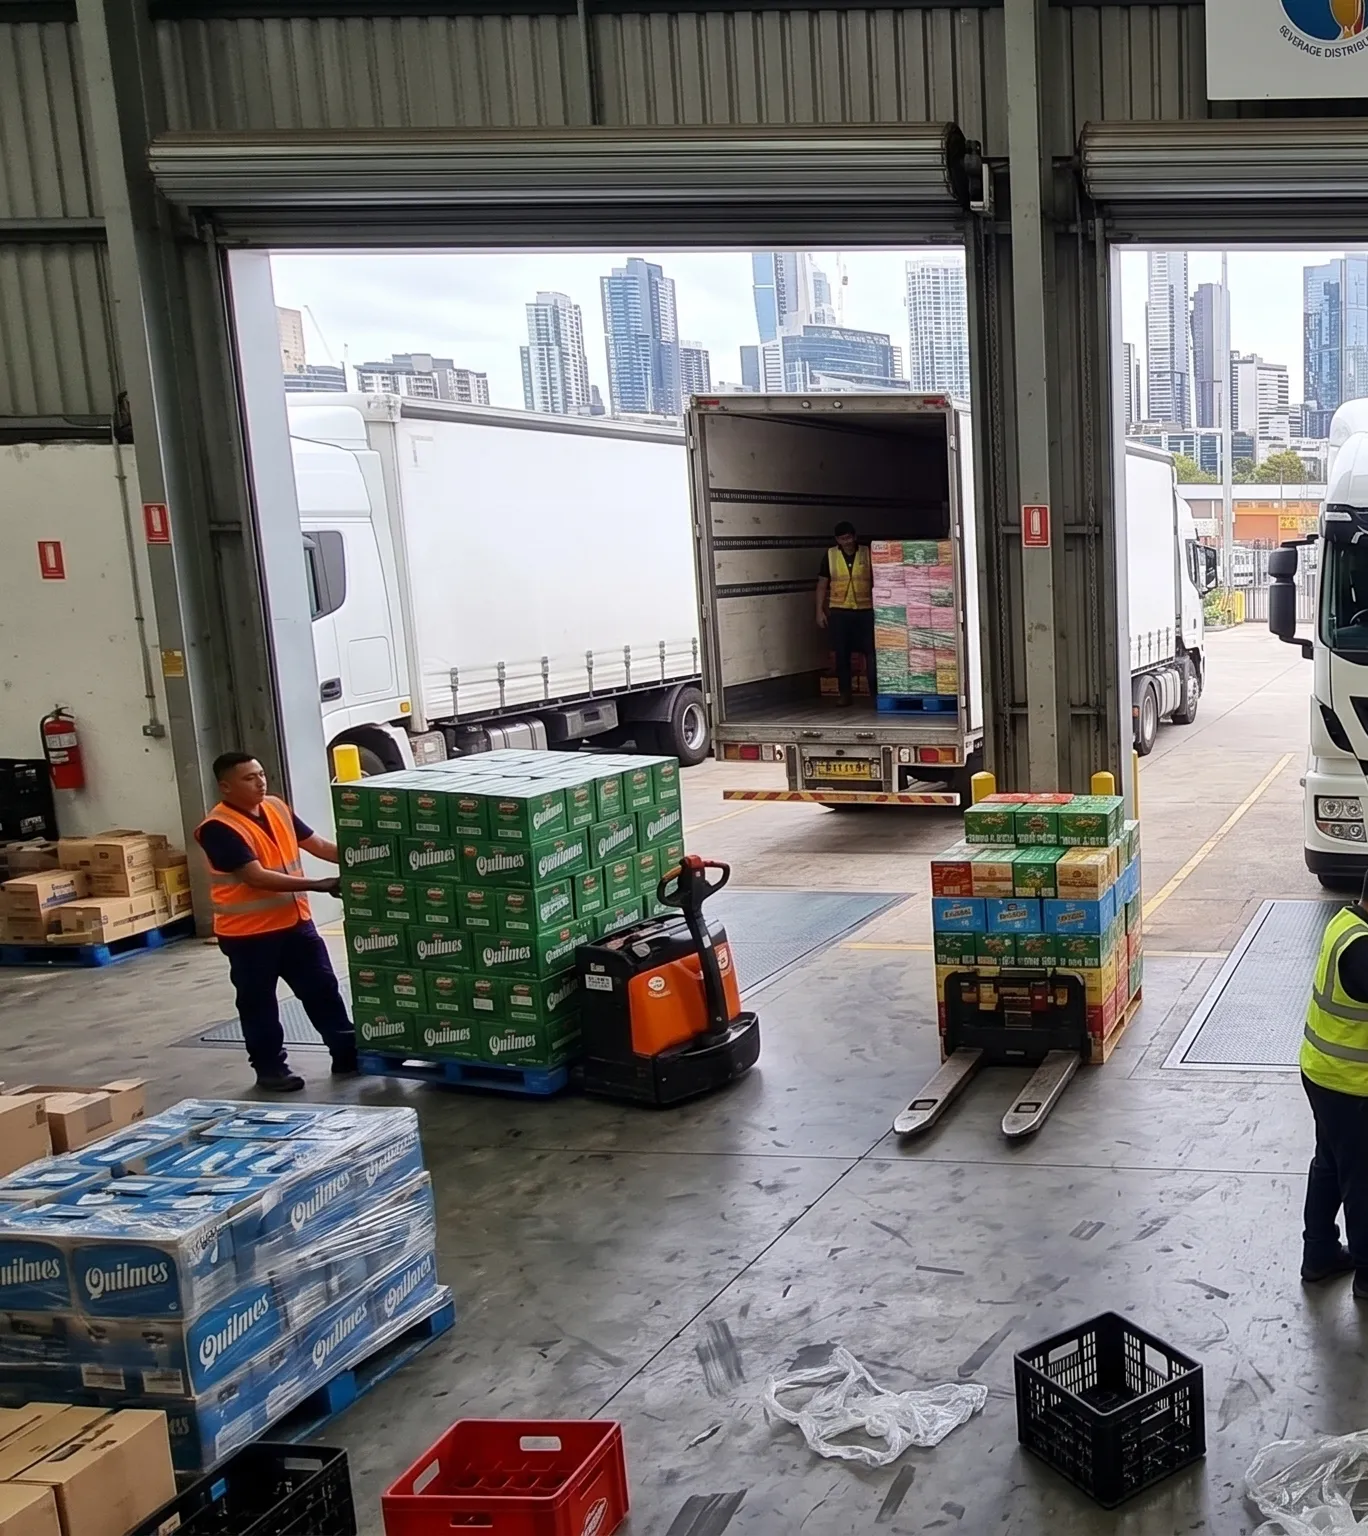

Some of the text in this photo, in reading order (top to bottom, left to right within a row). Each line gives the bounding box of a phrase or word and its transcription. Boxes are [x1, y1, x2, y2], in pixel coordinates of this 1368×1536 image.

[0, 1256, 61, 1289] uilmes
[84, 1261, 169, 1302] Quilmes
[200, 1292, 270, 1371] Quilmes
